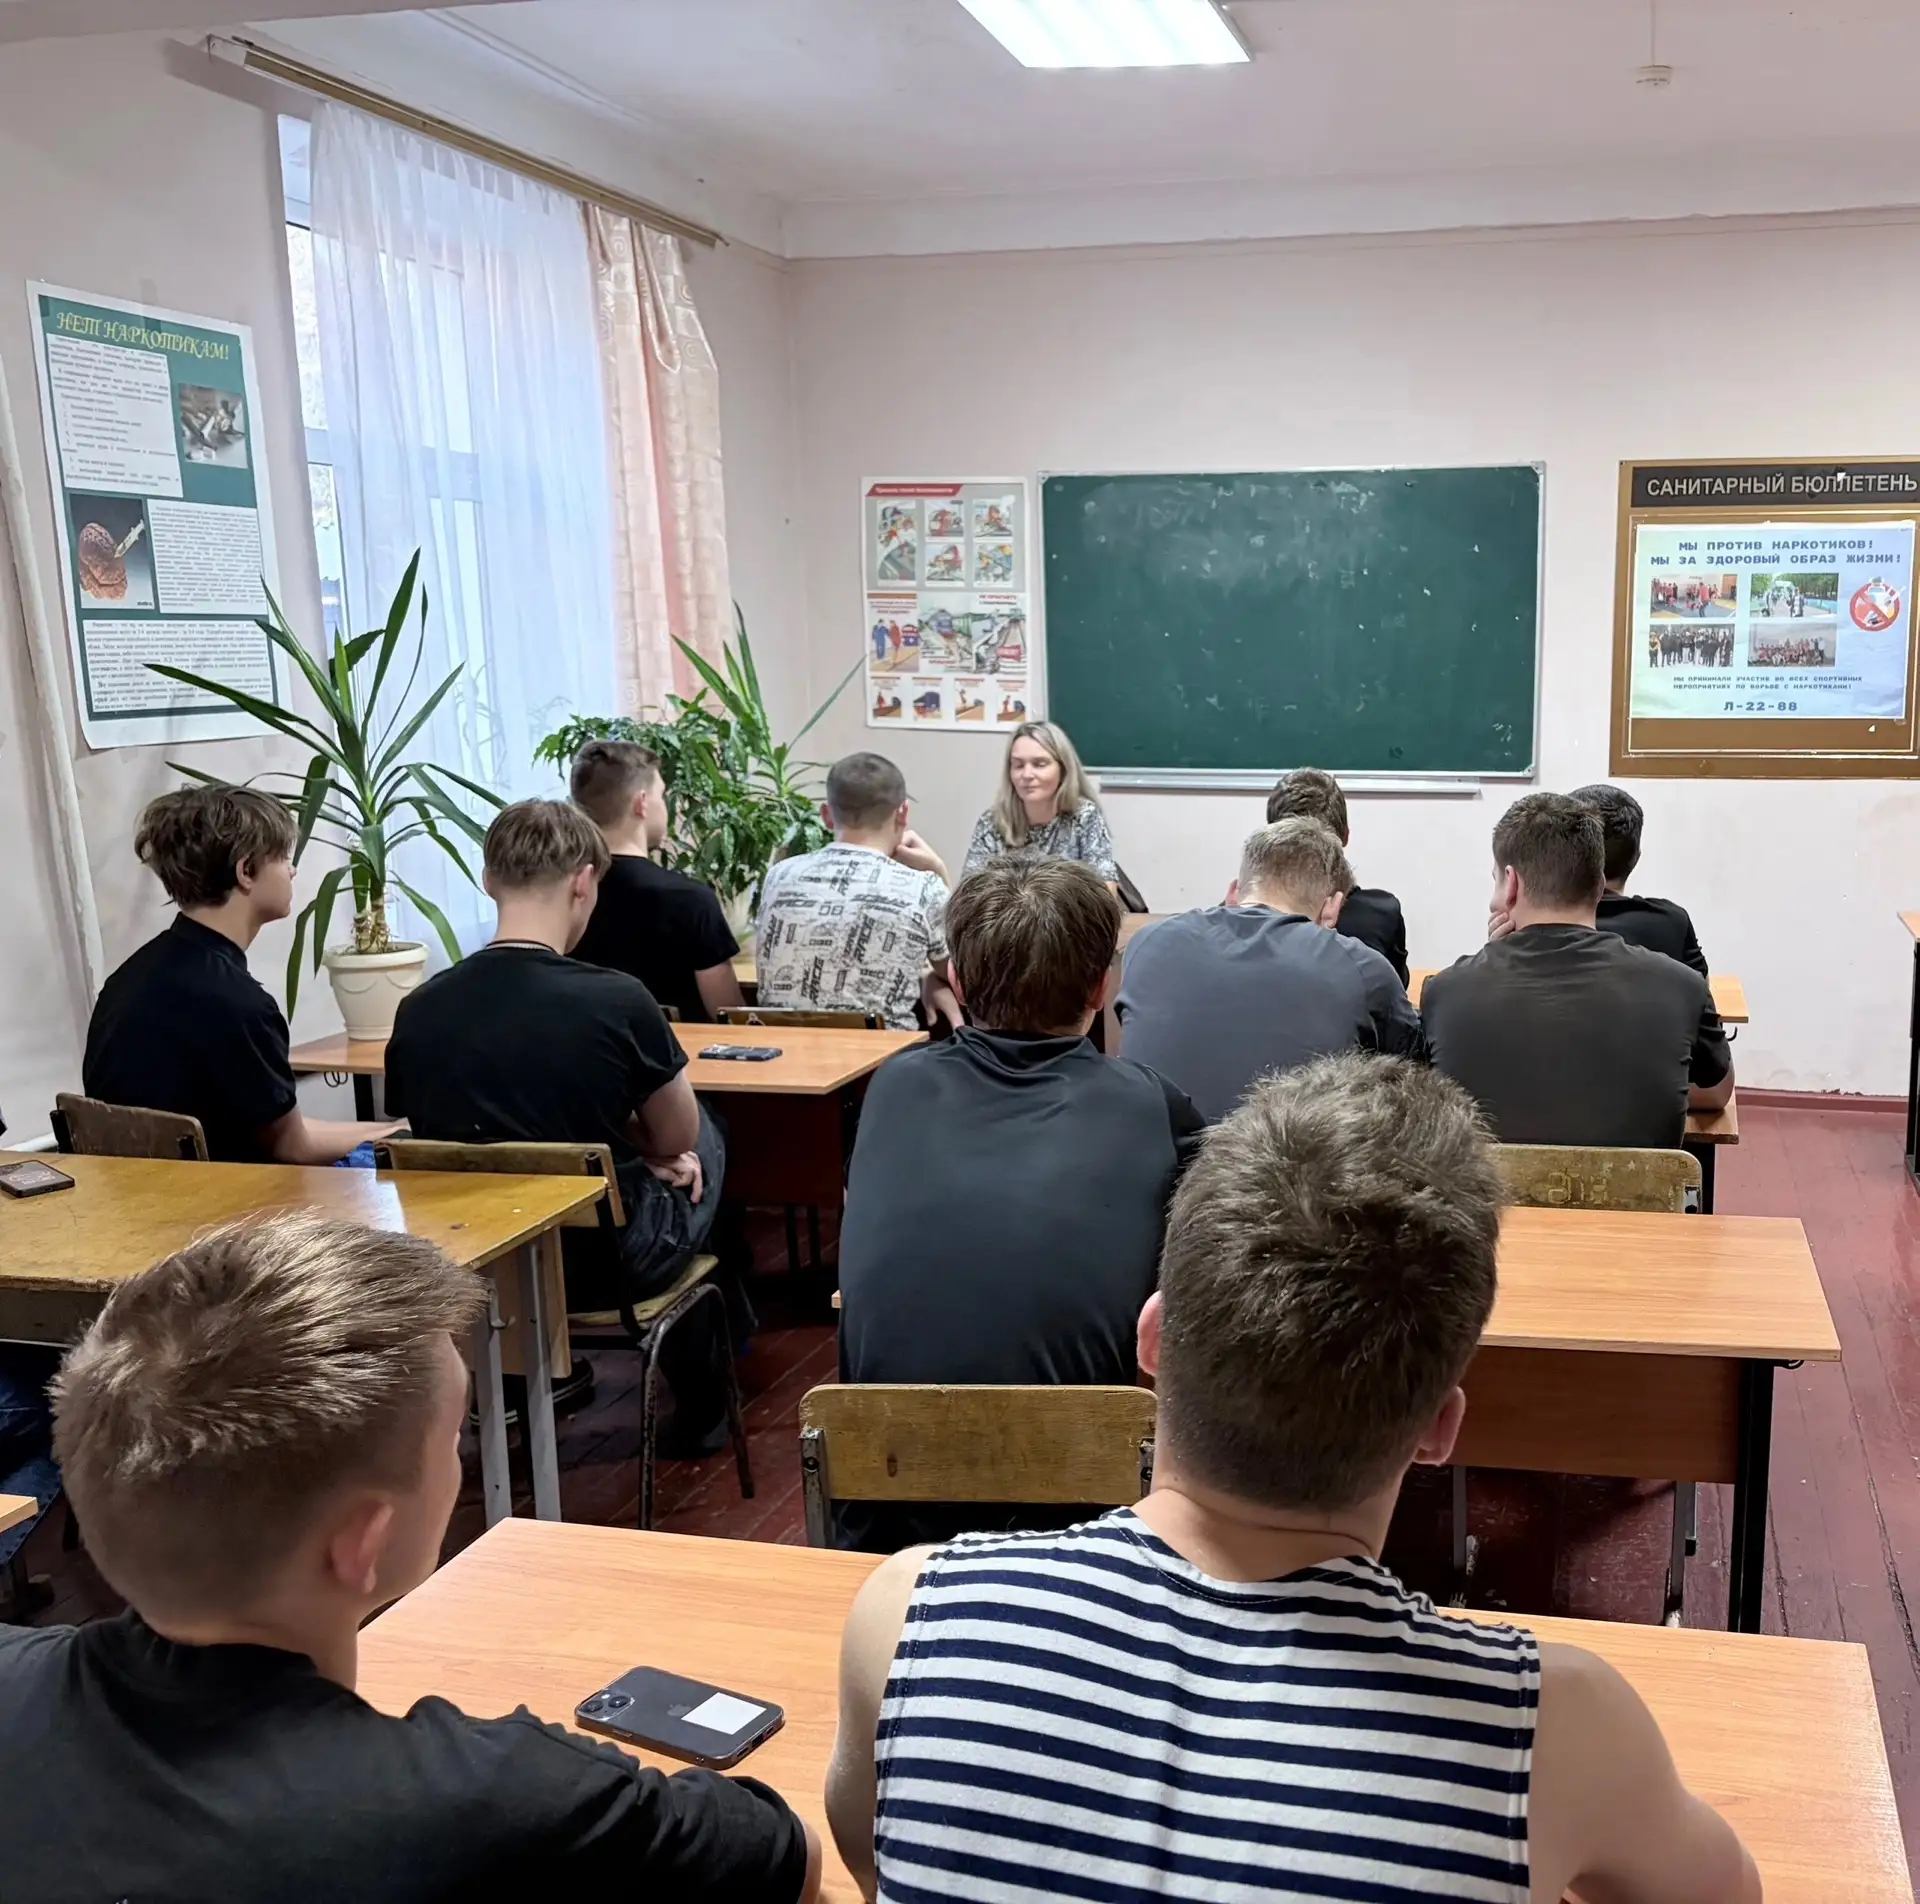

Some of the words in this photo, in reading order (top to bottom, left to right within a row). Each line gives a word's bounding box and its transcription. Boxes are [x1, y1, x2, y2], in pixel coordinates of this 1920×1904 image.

[57, 312, 102, 336] НЕТ
[103, 320, 229, 360] НАРКОТИКАМ!
[1647, 472, 1785, 496] САНИТАРНЫЙ
[1791, 473, 1918, 493] БЮЛЛЕТЕНЬ
[1679, 542, 1698, 551] МЫ
[1706, 541, 1763, 551] ПРОТИВ
[1772, 540, 1873, 550] НАРКОТИКОВ!
[1650, 556, 1670, 565] МЫ
[1678, 556, 1697, 565] ЗА
[1706, 553, 1781, 566] ЗДОРОВЫЙ
[1790, 554, 1837, 564] ОБРАЗ
[1846, 554, 1901, 564] ЖИЗНИ!
[1723, 701, 1798, 712] Л-22-88
